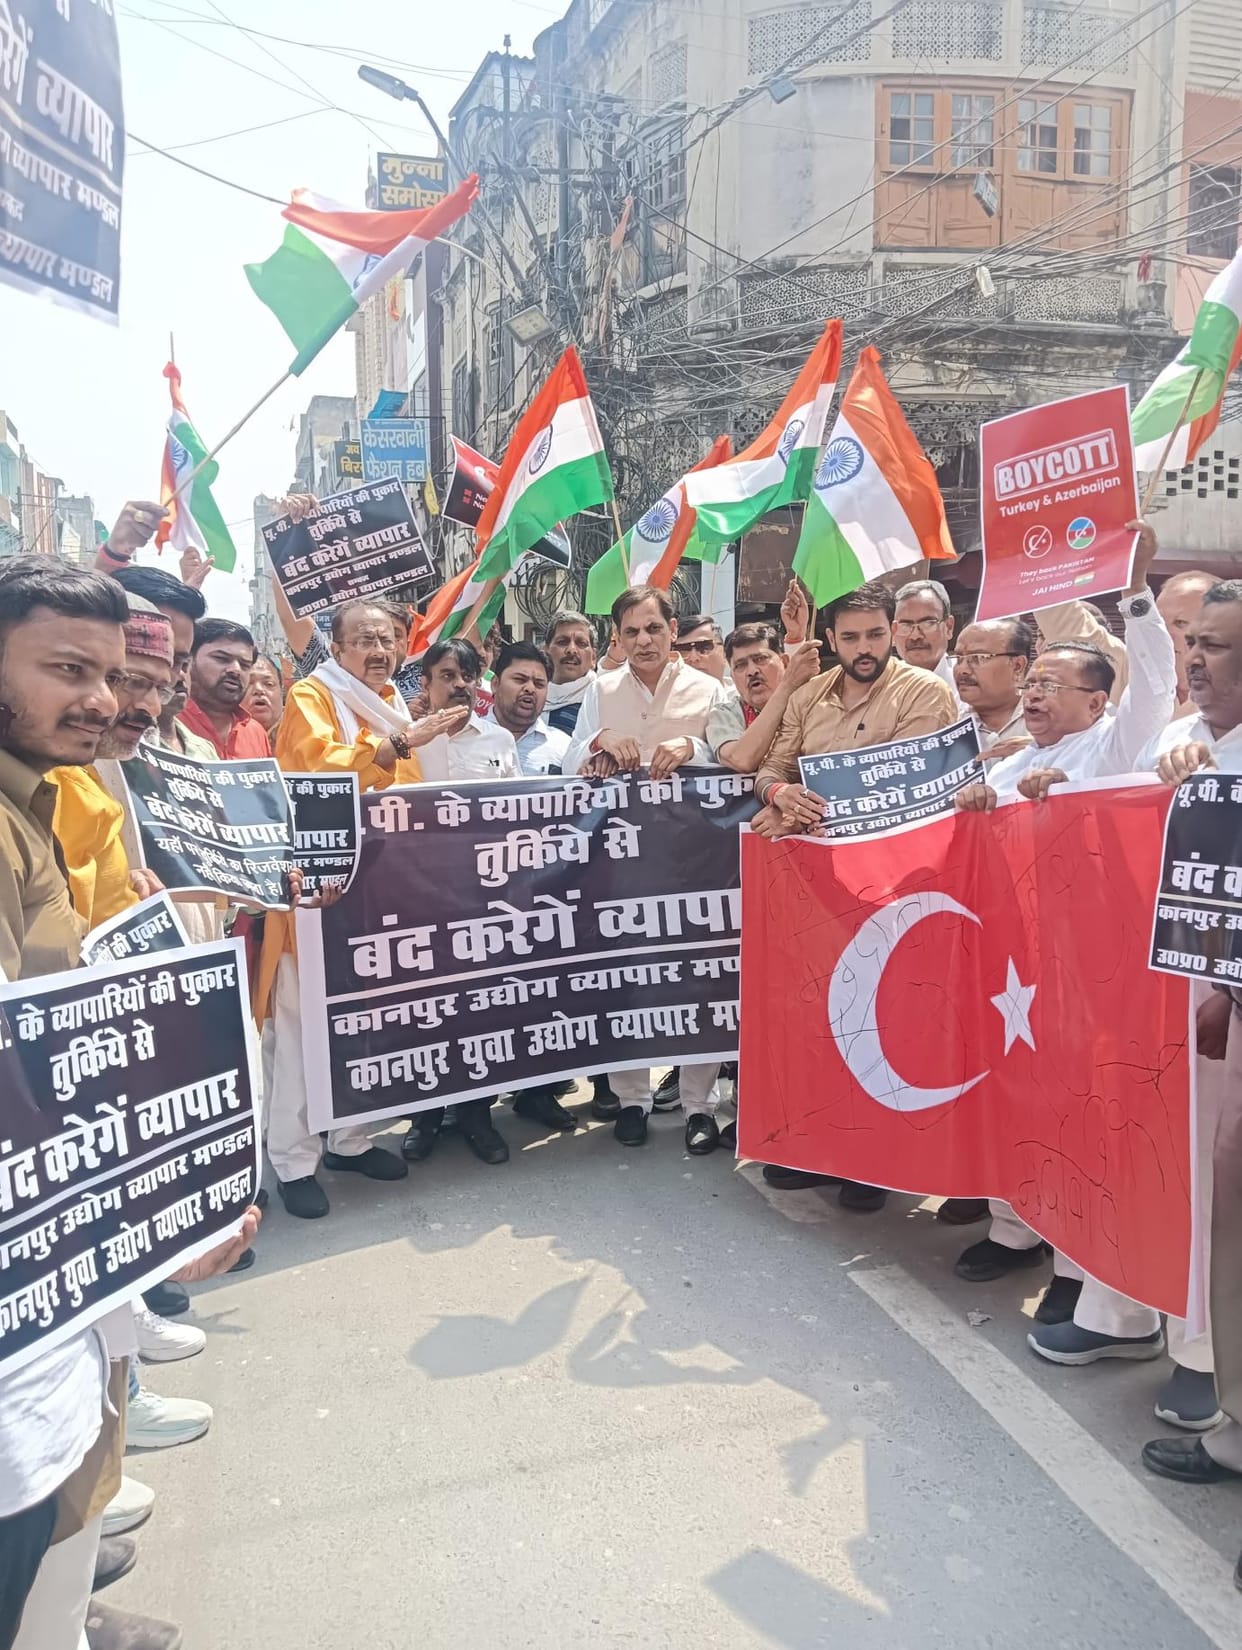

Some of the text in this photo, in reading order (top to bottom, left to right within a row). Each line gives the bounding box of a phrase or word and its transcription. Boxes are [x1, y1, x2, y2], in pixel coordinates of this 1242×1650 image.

[37, 58, 114, 171] व्यापार
[13, 139, 73, 201] व्यापार
[76, 180, 119, 231] मण्डल
[381, 156, 444, 184] मुन्ना
[381, 181, 445, 208] समोस
[59, 256, 113, 303] मण्डल
[363, 420, 425, 448] केसरवानी
[405, 460, 425, 480] हब
[998, 436, 1110, 494] BOYCOTT
[355, 490, 370, 504] की
[371, 482, 400, 501] पुकार
[1000, 475, 1121, 517] Turkey & Azerbaijan
[348, 509, 362, 524] से
[281, 522, 411, 578] बंद करेगें व्यापार
[286, 576, 322, 596] कानपुर
[352, 555, 387, 572] व्यापार
[388, 542, 423, 561] मण्डल
[359, 577, 394, 593] व्यापार
[394, 565, 429, 582] मण्डल
[1032, 581, 1073, 597] JAI HIND
[843, 755, 856, 768] के
[859, 740, 919, 764] व्यापारियों
[921, 737, 941, 751] की
[942, 722, 974, 747] पुकार
[911, 757, 927, 772] से
[206, 787, 225, 808] से
[214, 770, 235, 786] की
[237, 770, 277, 789] पुकार
[296, 781, 314, 795] की
[317, 782, 352, 798] पुकार
[434, 791, 470, 827] के
[479, 773, 631, 822] व्यापारियों
[637, 771, 686, 807] की
[854, 784, 907, 812] करेगें
[911, 758, 976, 798] व्यापार
[143, 791, 179, 823] बंद
[217, 823, 290, 846] व्यापार
[905, 800, 946, 821] व्यापार
[602, 816, 642, 859] से
[313, 856, 355, 867] मण्डल
[1171, 852, 1220, 894] बंद
[109, 932, 132, 958] की
[128, 910, 172, 952] पुकार
[348, 888, 741, 980] बंद करेगें व्यापा
[1158, 904, 1222, 931] कानपुर
[16, 1003, 45, 1041] के
[50, 975, 146, 1032] व्यापारियों
[148, 971, 176, 1006] की
[179, 963, 236, 1006] पुकार
[331, 992, 458, 1037] कानपुर
[467, 975, 559, 1013] उद्योग
[568, 961, 682, 991] व्यापार
[132, 1019, 156, 1061] से
[346, 1041, 450, 1091] कानपुर
[458, 1028, 516, 1080] युवा
[524, 1010, 599, 1057] उद्योग
[606, 1003, 700, 1040] व्यापार
[40, 1094, 128, 1182] करेगें
[134, 1068, 240, 1141] व्यापार
[0, 1126, 253, 1270] ानपुर उद्योग व्यापार मण्डल
[61, 1246, 99, 1308] युवा
[101, 1220, 152, 1274] उद्योग
[152, 1191, 204, 1242] व्यापार
[205, 1166, 252, 1213] मण्डल
